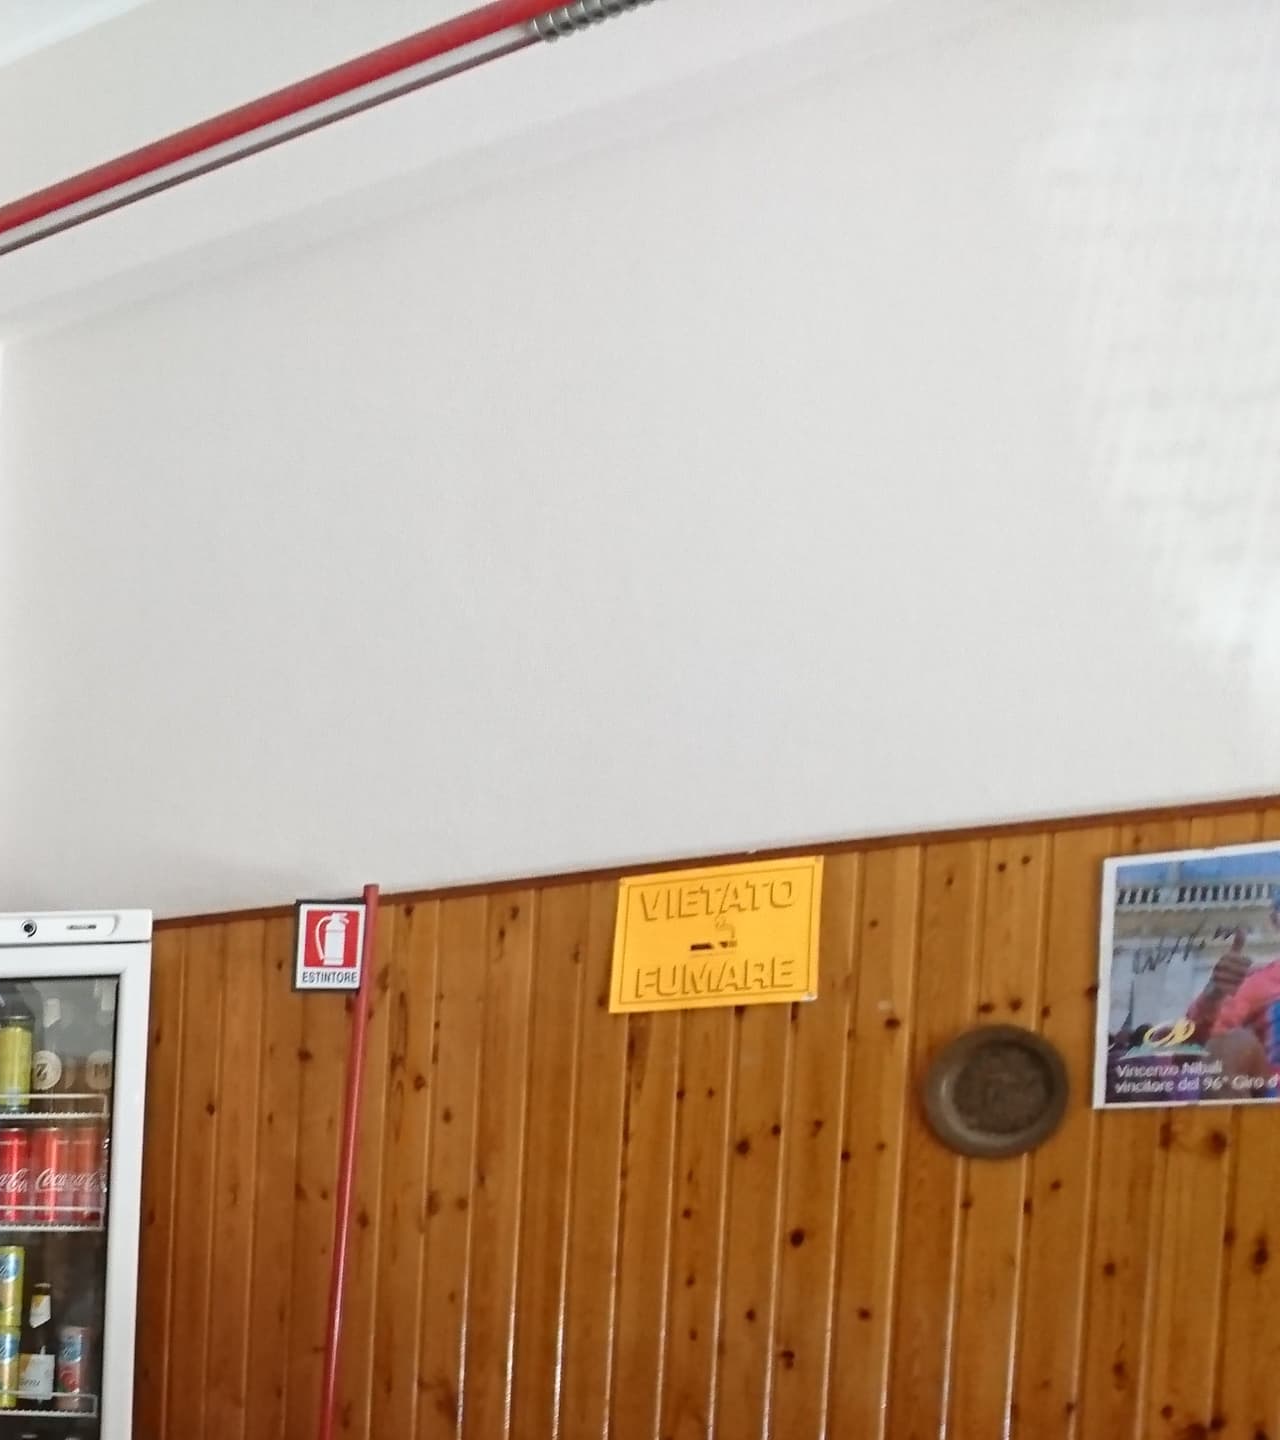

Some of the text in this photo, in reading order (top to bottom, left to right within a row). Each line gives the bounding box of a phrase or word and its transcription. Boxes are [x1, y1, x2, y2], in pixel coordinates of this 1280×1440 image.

[640, 880, 793, 921] VIETATO
[302, 971, 358, 983] ESTINTORE
[635, 957, 795, 998] FUMARE
[1115, 1059, 1223, 1078] Vincenzo Nibali
[1114, 1079, 1175, 1094] vincitore
[1177, 1077, 1201, 1091] del
[1231, 1076, 1265, 1090] Giro
